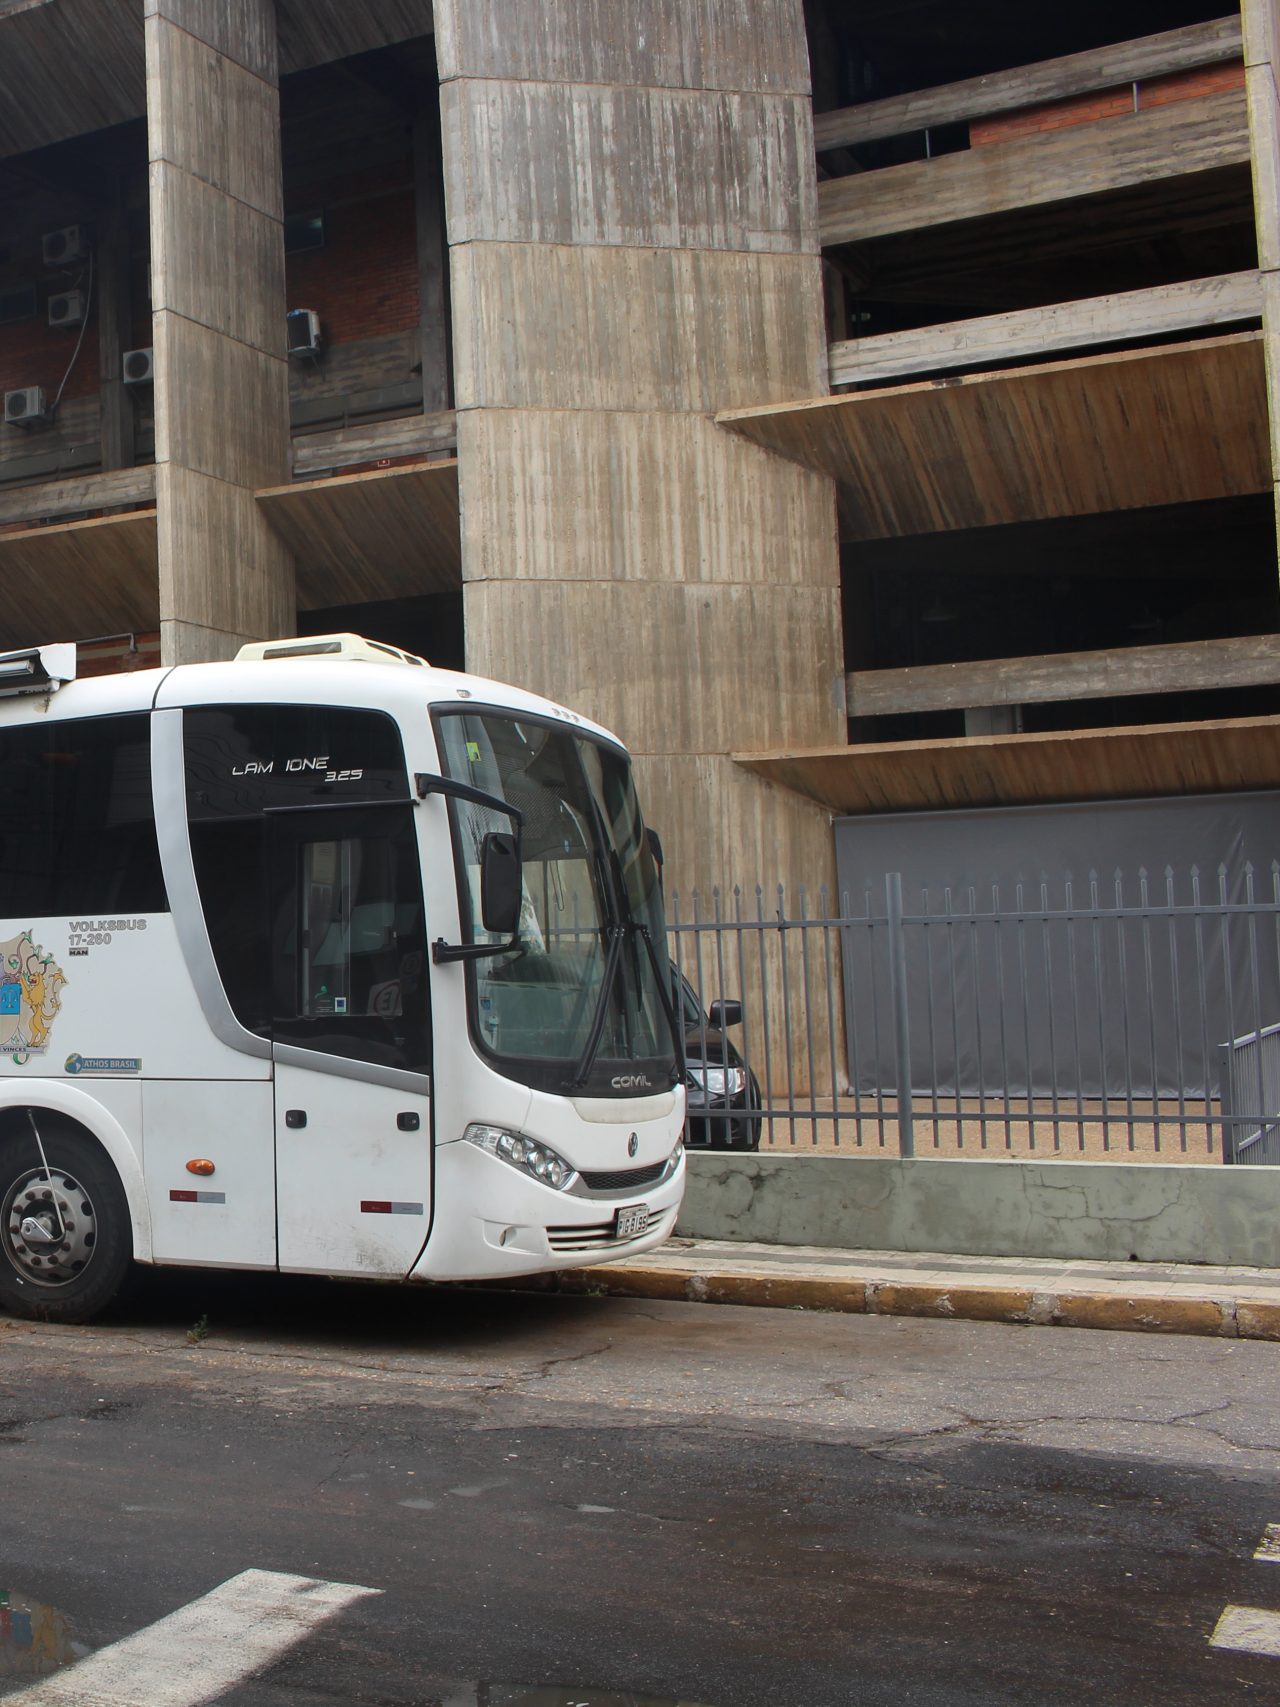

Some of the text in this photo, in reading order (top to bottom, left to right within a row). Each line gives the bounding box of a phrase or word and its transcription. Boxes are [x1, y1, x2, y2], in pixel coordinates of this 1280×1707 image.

[69, 919, 147, 932] VOLKSBUS
[68, 933, 112, 946] 17-260
[84, 1060, 136, 1068] ATHOS BRASIL
